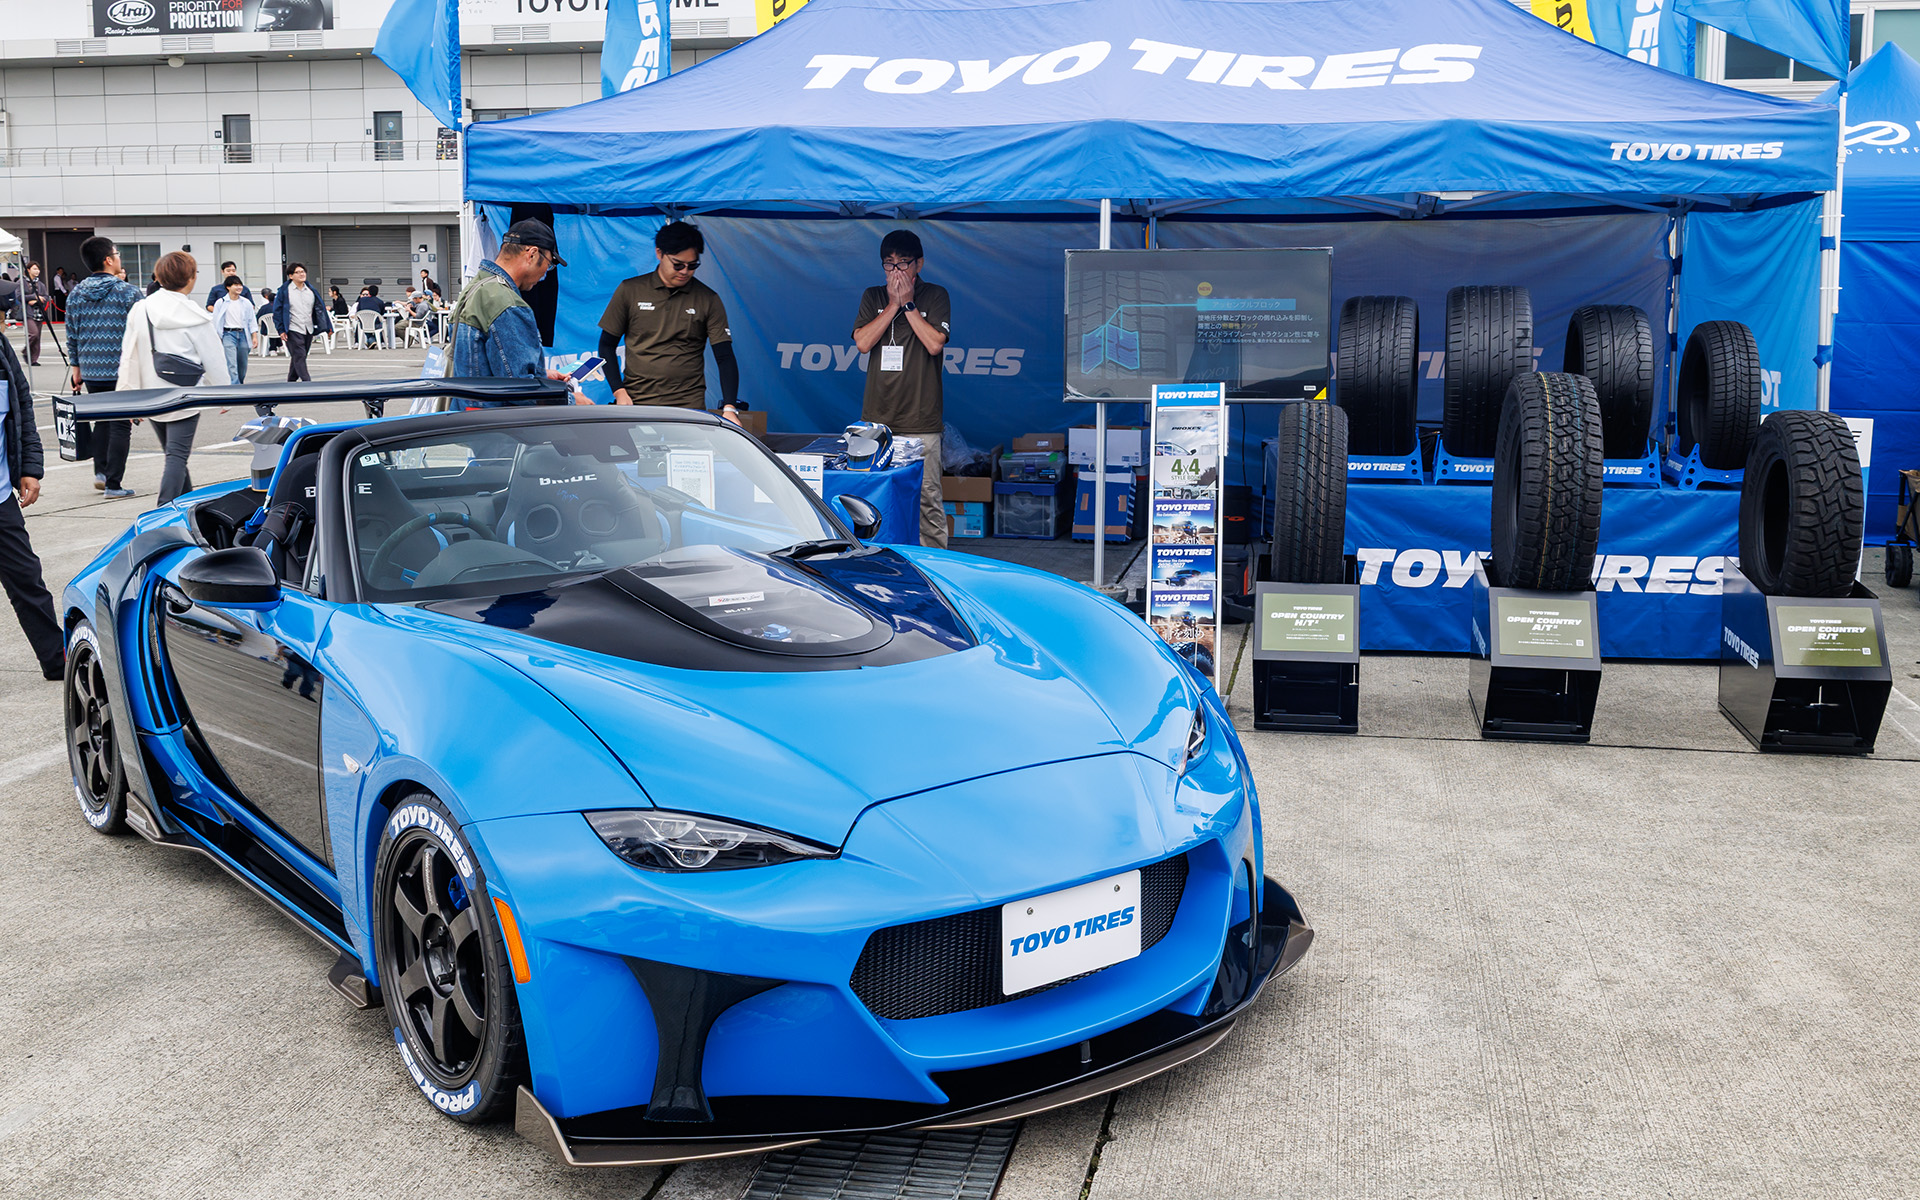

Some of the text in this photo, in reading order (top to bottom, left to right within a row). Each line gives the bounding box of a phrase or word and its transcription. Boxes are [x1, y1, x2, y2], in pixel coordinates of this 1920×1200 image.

[112, 3, 148, 17] Arai
[169, 0, 243, 12] PRIORITY FOR
[169, 10, 243, 30] PROTECTION
[803, 38, 1483, 94] TOYO TIRES
[1609, 141, 1784, 162] TOYO TIRES
[1158, 390, 1219, 400] TOYO TIRES
[364, 454, 373, 463] 9
[1372, 462, 1406, 471] TIRES
[1454, 463, 1486, 473] TOYO
[1608, 466, 1643, 475] TIRES
[1155, 503, 1212, 512] TOYO TIRES
[1183, 548, 1212, 556] TIRES
[1357, 548, 1740, 596] TOY IRES
[1154, 593, 1210, 602] TOYO TIRES
[1299, 612, 1345, 620] COUNTRY
[1536, 617, 1582, 626] COUNTRY
[1724, 625, 1760, 670] TOYO TIRES
[391, 805, 474, 878] TOYO TIRES
[1009, 905, 1136, 957] TOYO TIRES
[397, 1040, 475, 1113] PROXES
